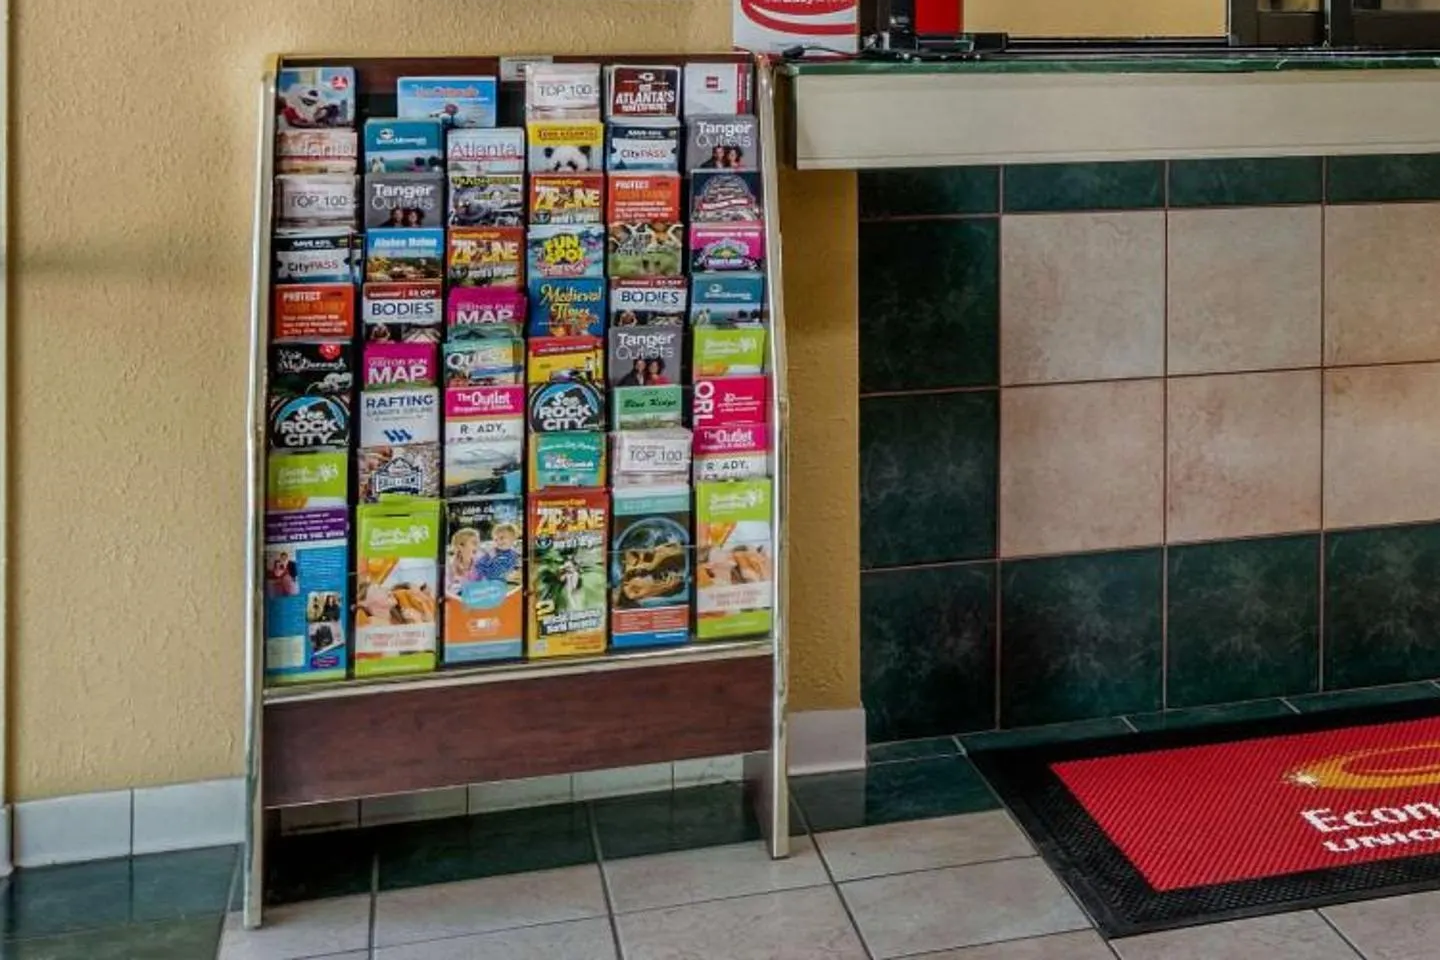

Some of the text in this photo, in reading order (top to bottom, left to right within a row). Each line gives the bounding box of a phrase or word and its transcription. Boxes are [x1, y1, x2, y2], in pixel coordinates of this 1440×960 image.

[697, 121, 752, 136] Tanger
[451, 141, 518, 157] Atlanta
[372, 183, 435, 198] Tanger
[540, 284, 602, 305] Medieval
[621, 291, 679, 304] BODIES
[372, 302, 434, 315] BODIES
[457, 309, 514, 324] MAP
[617, 333, 677, 347] Tanger
[368, 364, 428, 384] MAP
[366, 395, 433, 408] RAFTING
[472, 390, 510, 406] Outlet
[539, 405, 592, 419] ROCK
[281, 420, 339, 434] ROCK
[543, 417, 588, 430] CITY
[284, 431, 333, 446] CITY
